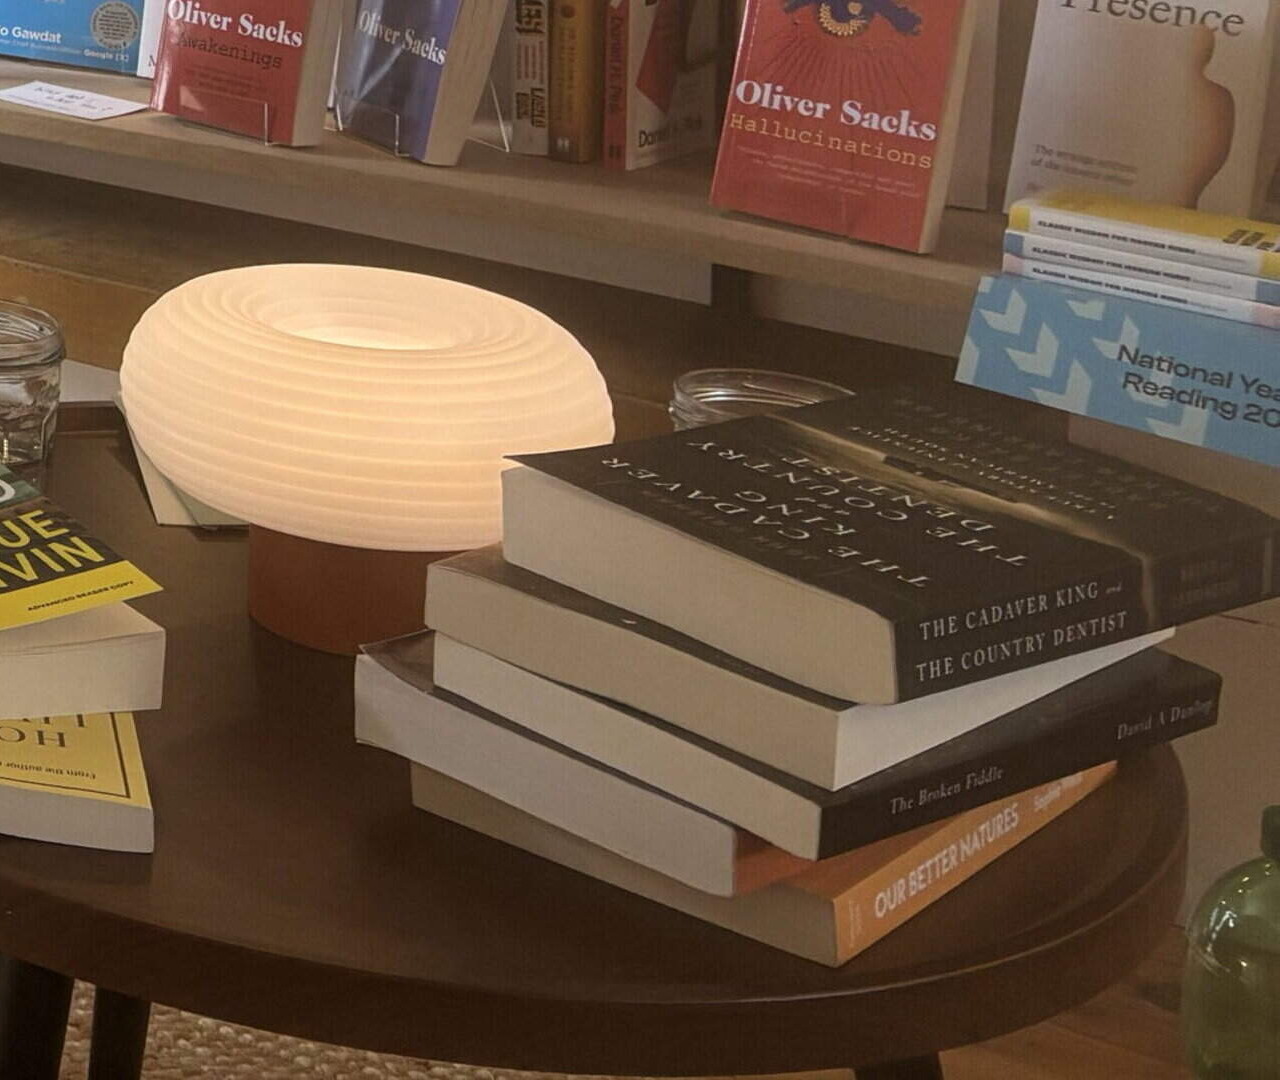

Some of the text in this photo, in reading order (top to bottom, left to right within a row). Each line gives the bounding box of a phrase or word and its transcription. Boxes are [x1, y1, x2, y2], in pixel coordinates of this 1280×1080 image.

[11, 26, 62, 44] Gawdat
[176, 31, 282, 69] Awakenings
[237, 14, 303, 48] Sacks
[359, 9, 446, 66] Oliver Sacks
[736, 79, 937, 141] Oliver Sacks
[730, 113, 932, 169] Hallucinations
[1116, 344, 1234, 389] National
[1122, 372, 1238, 420] Reading
[601, 456, 810, 540] CADAVER
[687, 440, 908, 521] COUNTRY
[782, 455, 994, 532] DENTIST
[737, 489, 857, 537] KING
[827, 544, 930, 588] THE
[926, 526, 1029, 567] THE
[27, 594, 76, 611] ADVANCED
[110, 580, 135, 592] COPY
[919, 581, 1099, 641] THE CADAVER KING
[916, 610, 1128, 683] THE COUNTRY DENTIST
[5, 762, 43, 773] author
[45, 767, 64, 776] the
[66, 770, 97, 780] From
[890, 766, 1004, 815] The Broken Fiddle
[874, 802, 1020, 918] OUR BETTER NATURES
